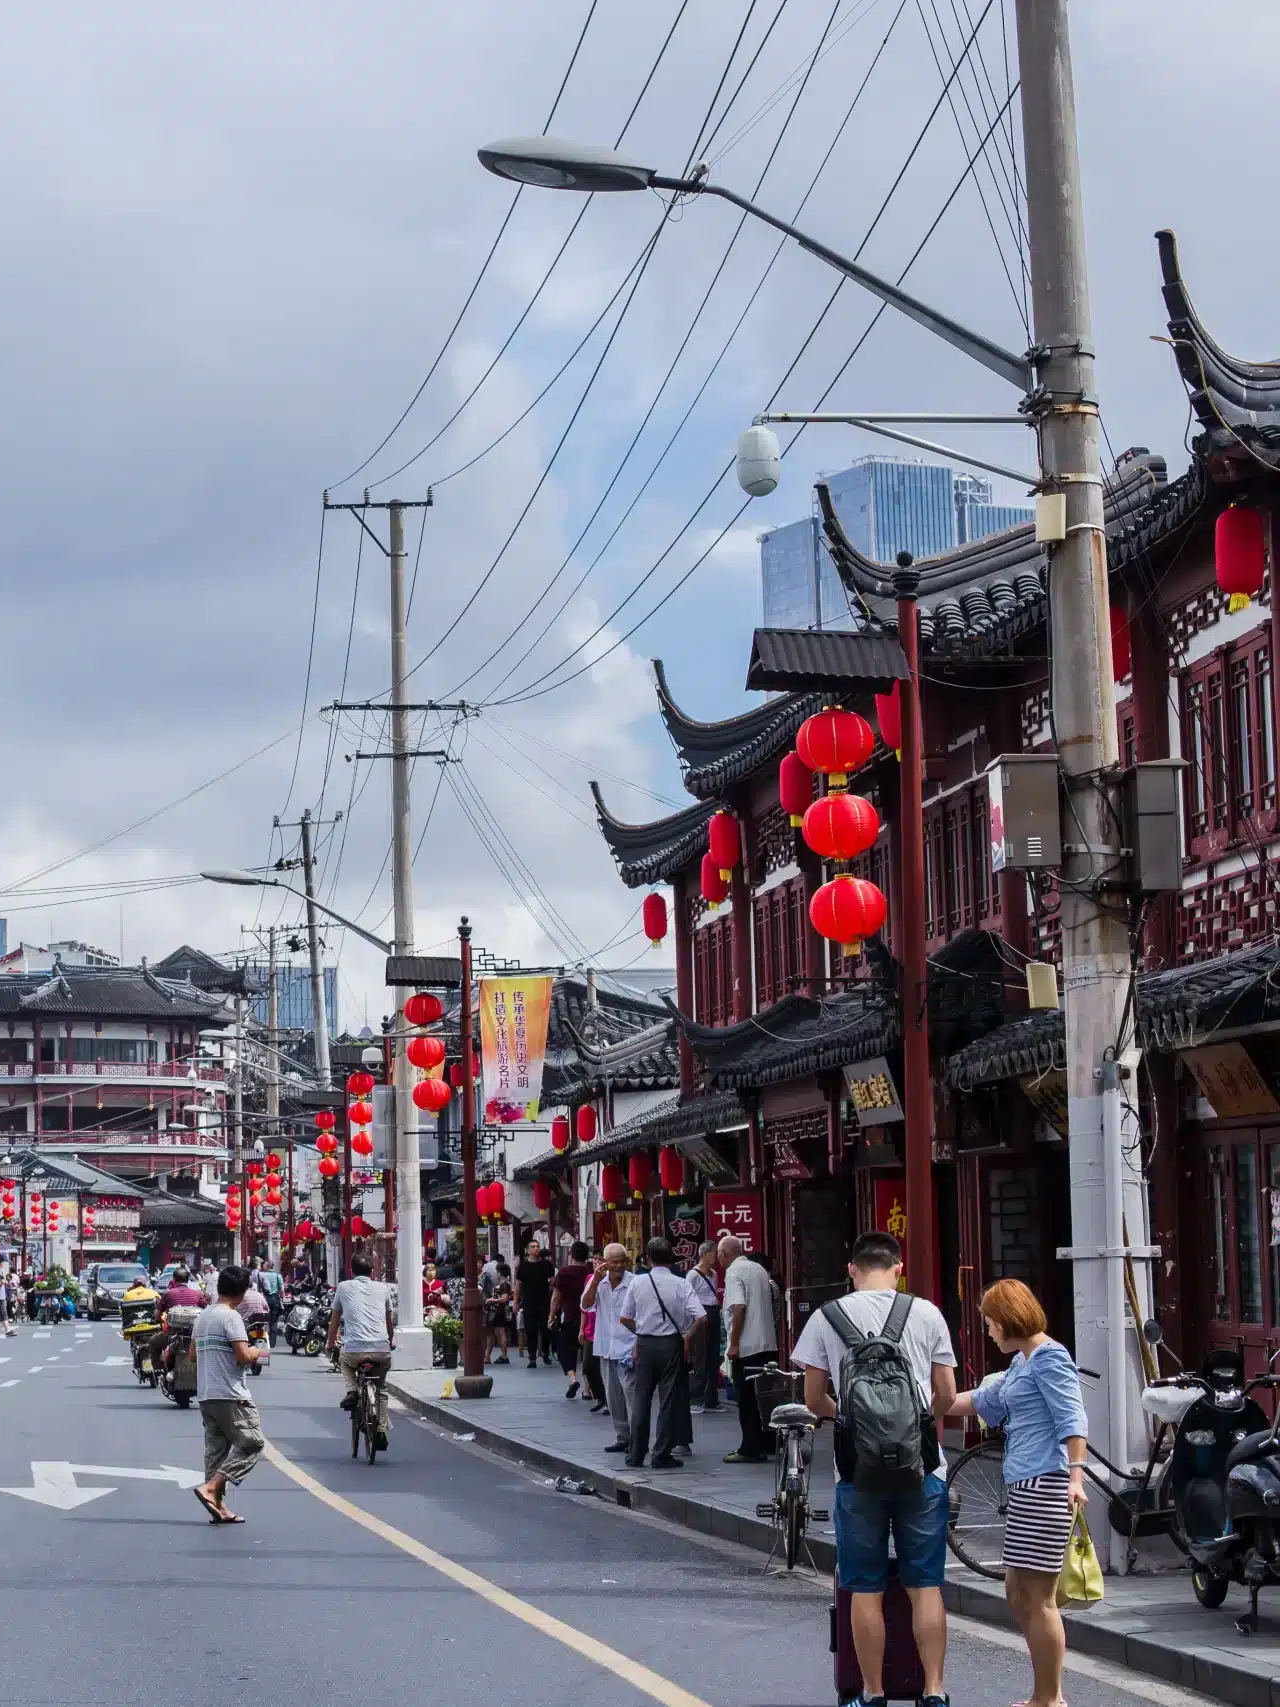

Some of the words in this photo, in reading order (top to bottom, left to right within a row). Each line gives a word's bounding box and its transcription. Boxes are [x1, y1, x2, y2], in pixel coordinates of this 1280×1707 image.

[494, 991, 510, 1088] 打造文化旅游名片
[513, 991, 529, 1088] 传承华夏历史文明
[714, 1204, 753, 1224] 十元
